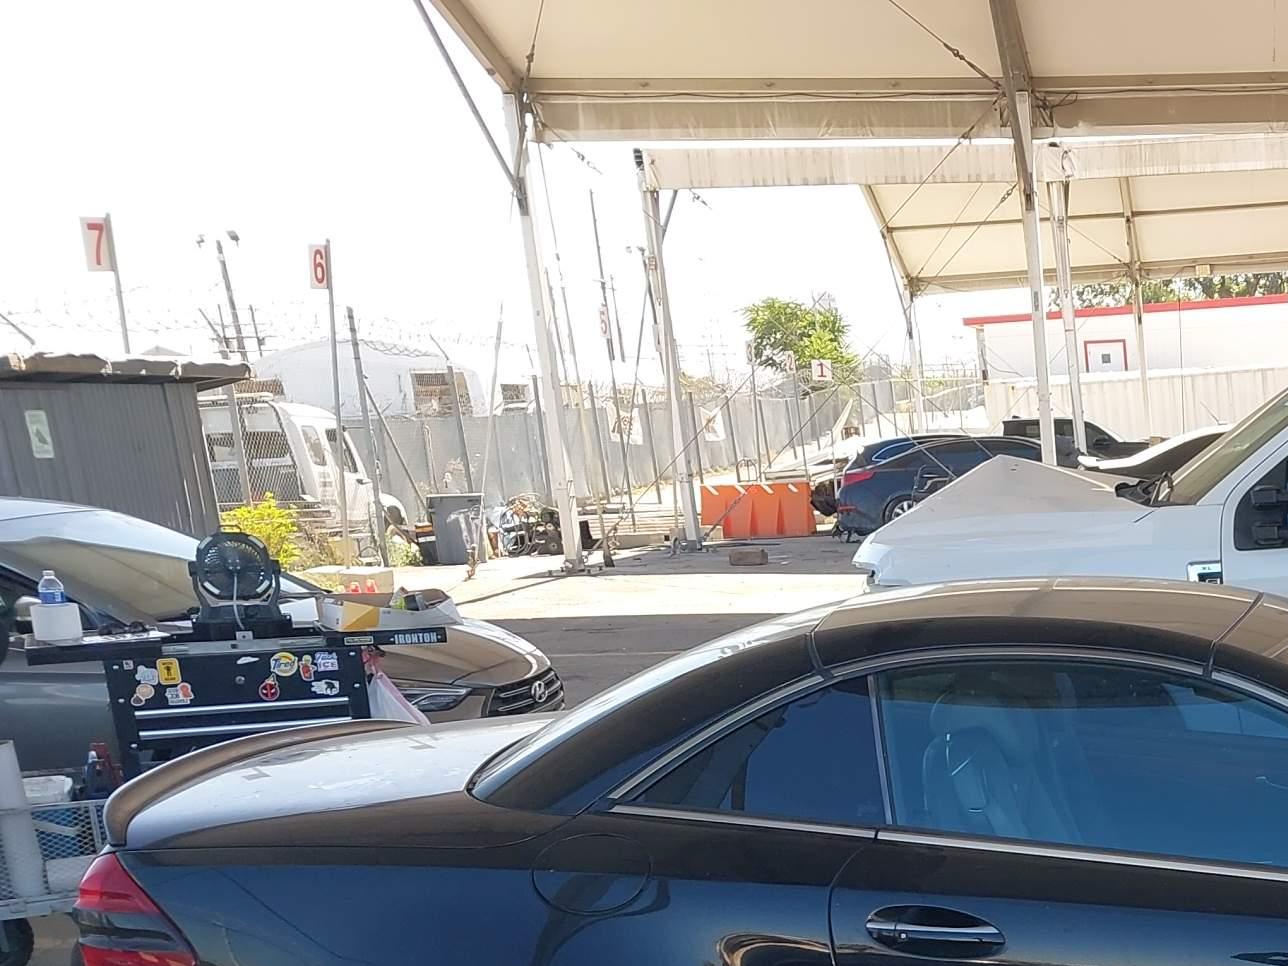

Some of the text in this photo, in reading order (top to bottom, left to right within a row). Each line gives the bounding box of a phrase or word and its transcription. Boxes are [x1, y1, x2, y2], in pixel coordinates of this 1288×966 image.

[86, 222, 105, 266] 7
[313, 248, 326, 284] 6
[816, 362, 827, 378] 1
[394, 632, 437, 644] IRONTON
